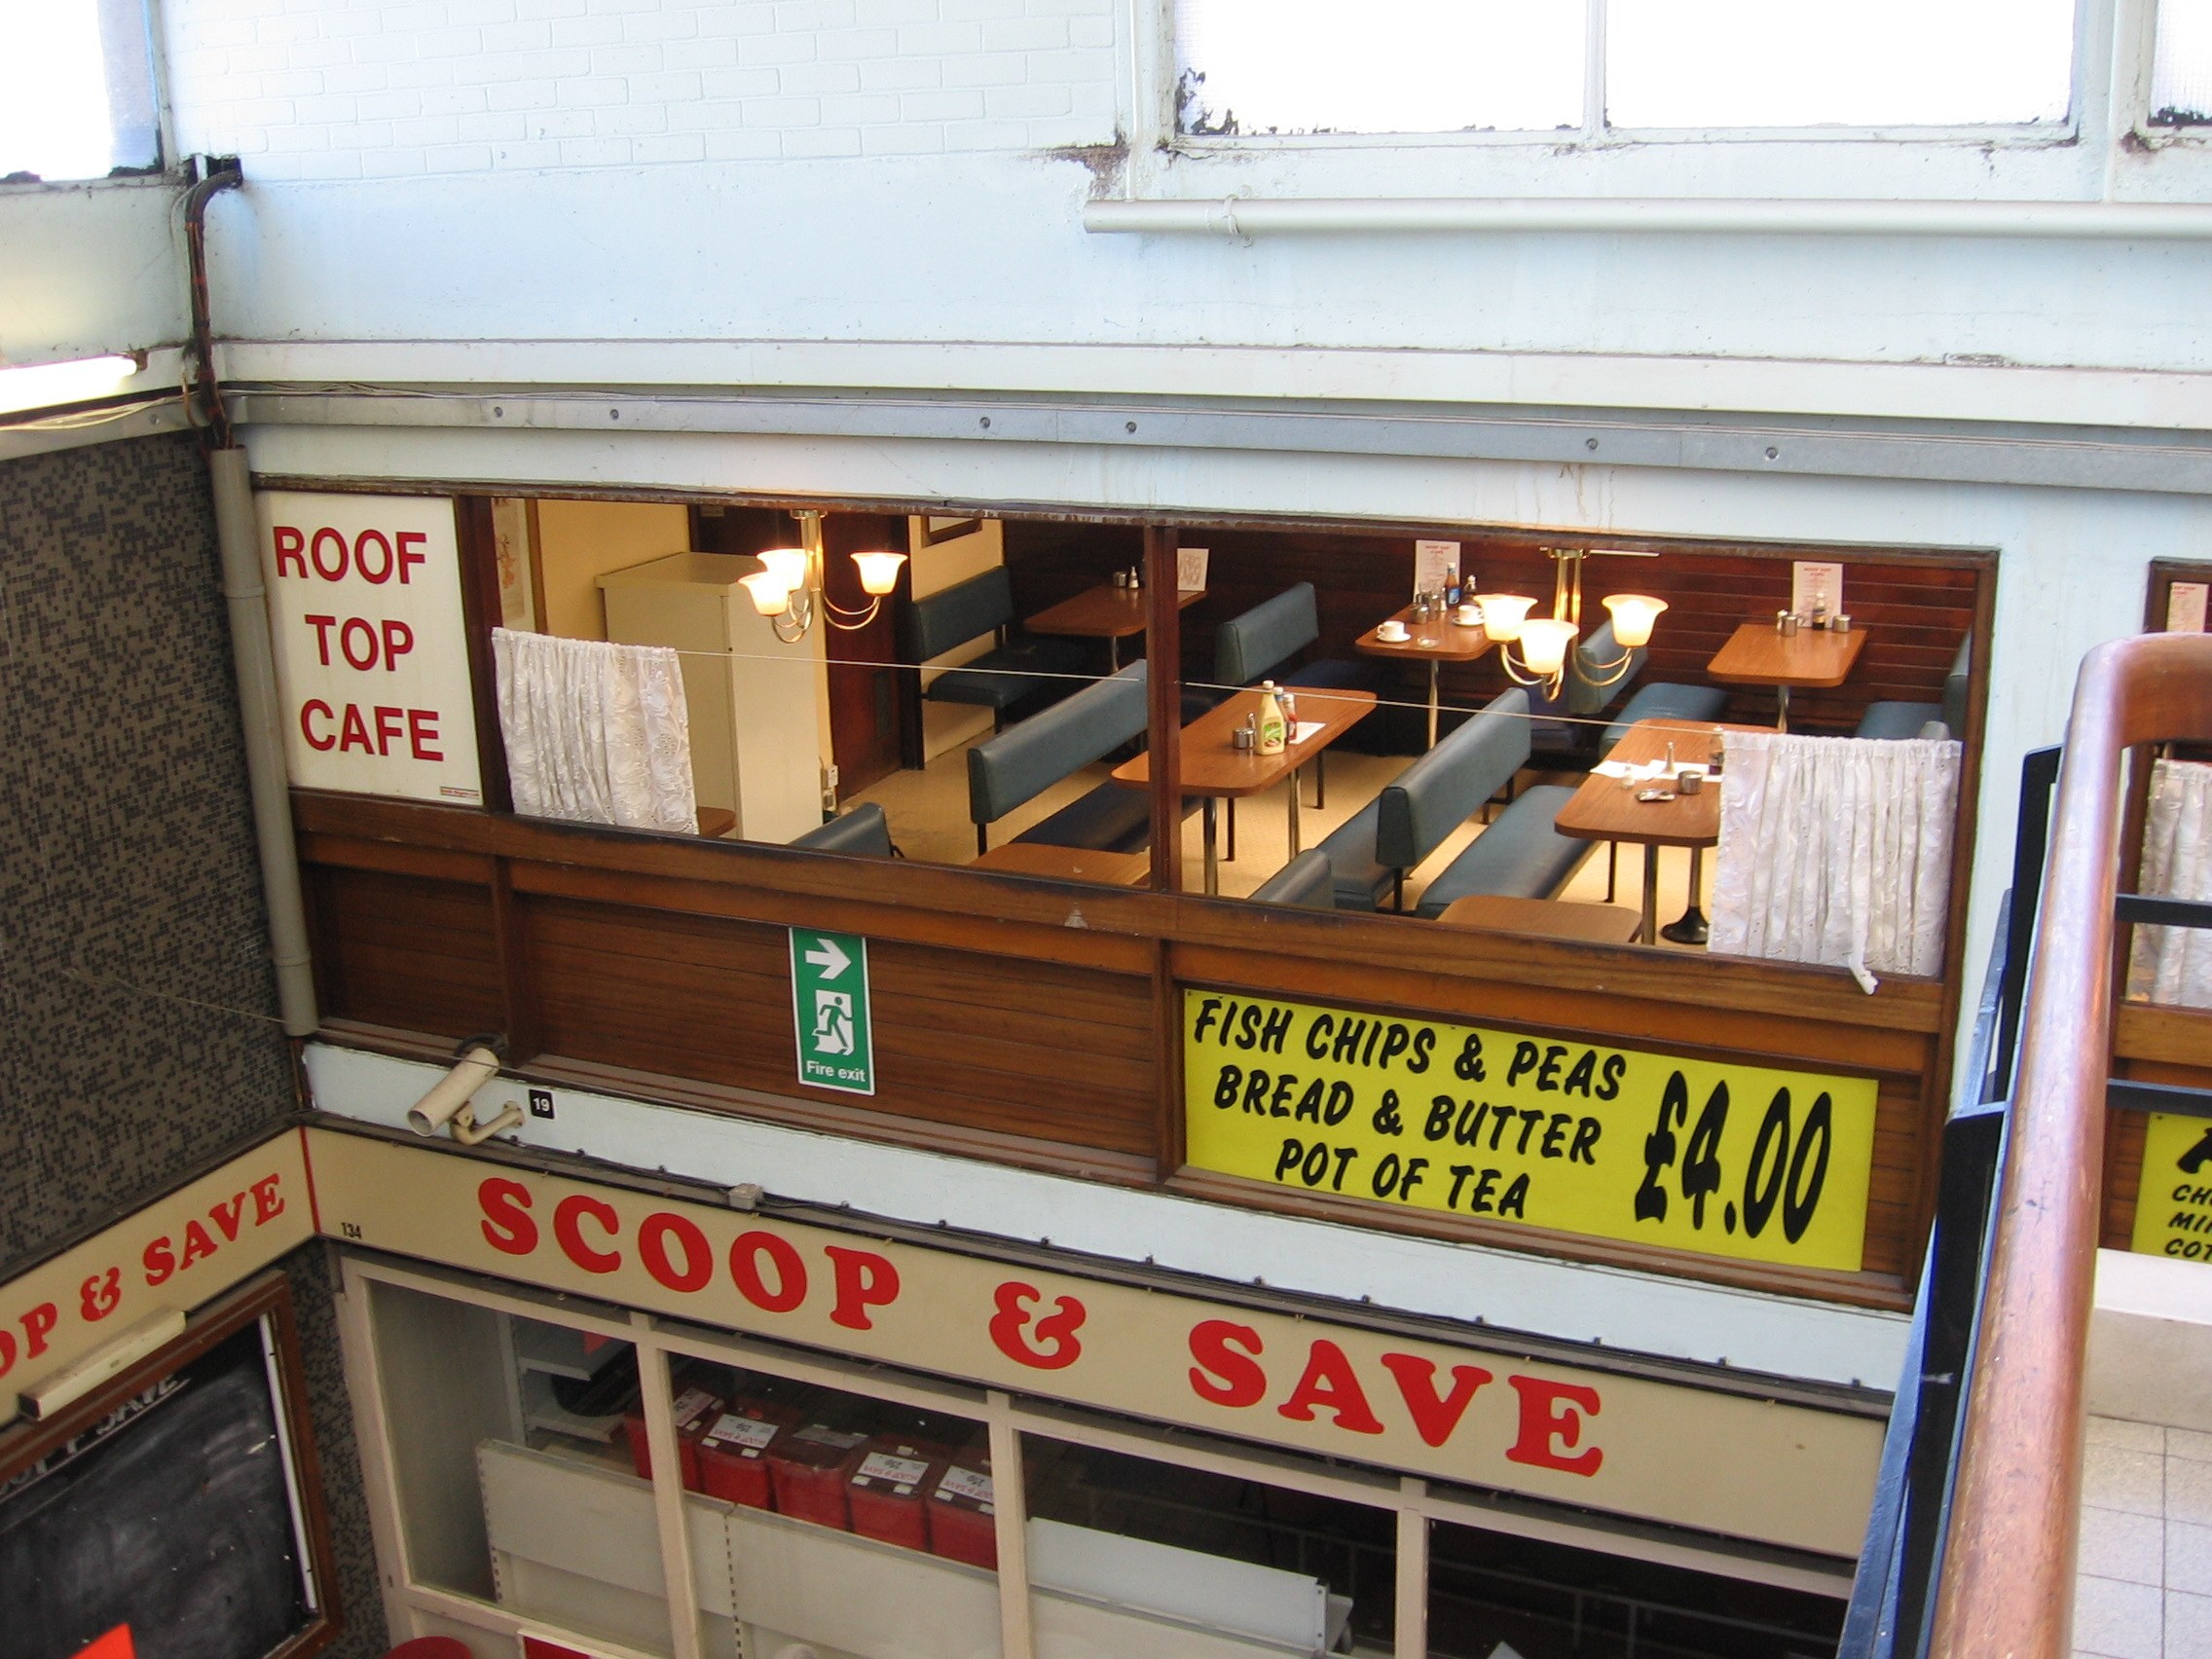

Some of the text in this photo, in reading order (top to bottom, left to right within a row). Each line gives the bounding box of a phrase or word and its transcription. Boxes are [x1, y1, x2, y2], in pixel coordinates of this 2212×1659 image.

[274, 526, 427, 584] ROOF
[305, 614, 414, 672] TOP
[300, 699, 444, 762] CAFE
[806, 1059, 866, 1083] Fire exit
[1195, 998, 1627, 1101] FISH CHIPS & PEAS
[533, 1096, 550, 1112] 19
[1213, 1065, 1602, 1166] BREAD & BUTTER
[1274, 1138, 1530, 1220] POT OF TEA
[1634, 1070, 1832, 1245] £4.00
[2172, 1184, 2212, 1206] CH
[81, 1267, 123, 1322] &
[143, 1173, 286, 1286] SAVE
[342, 1222, 362, 1240] 134
[479, 1176, 1604, 1478] SCOOP & SAVE
